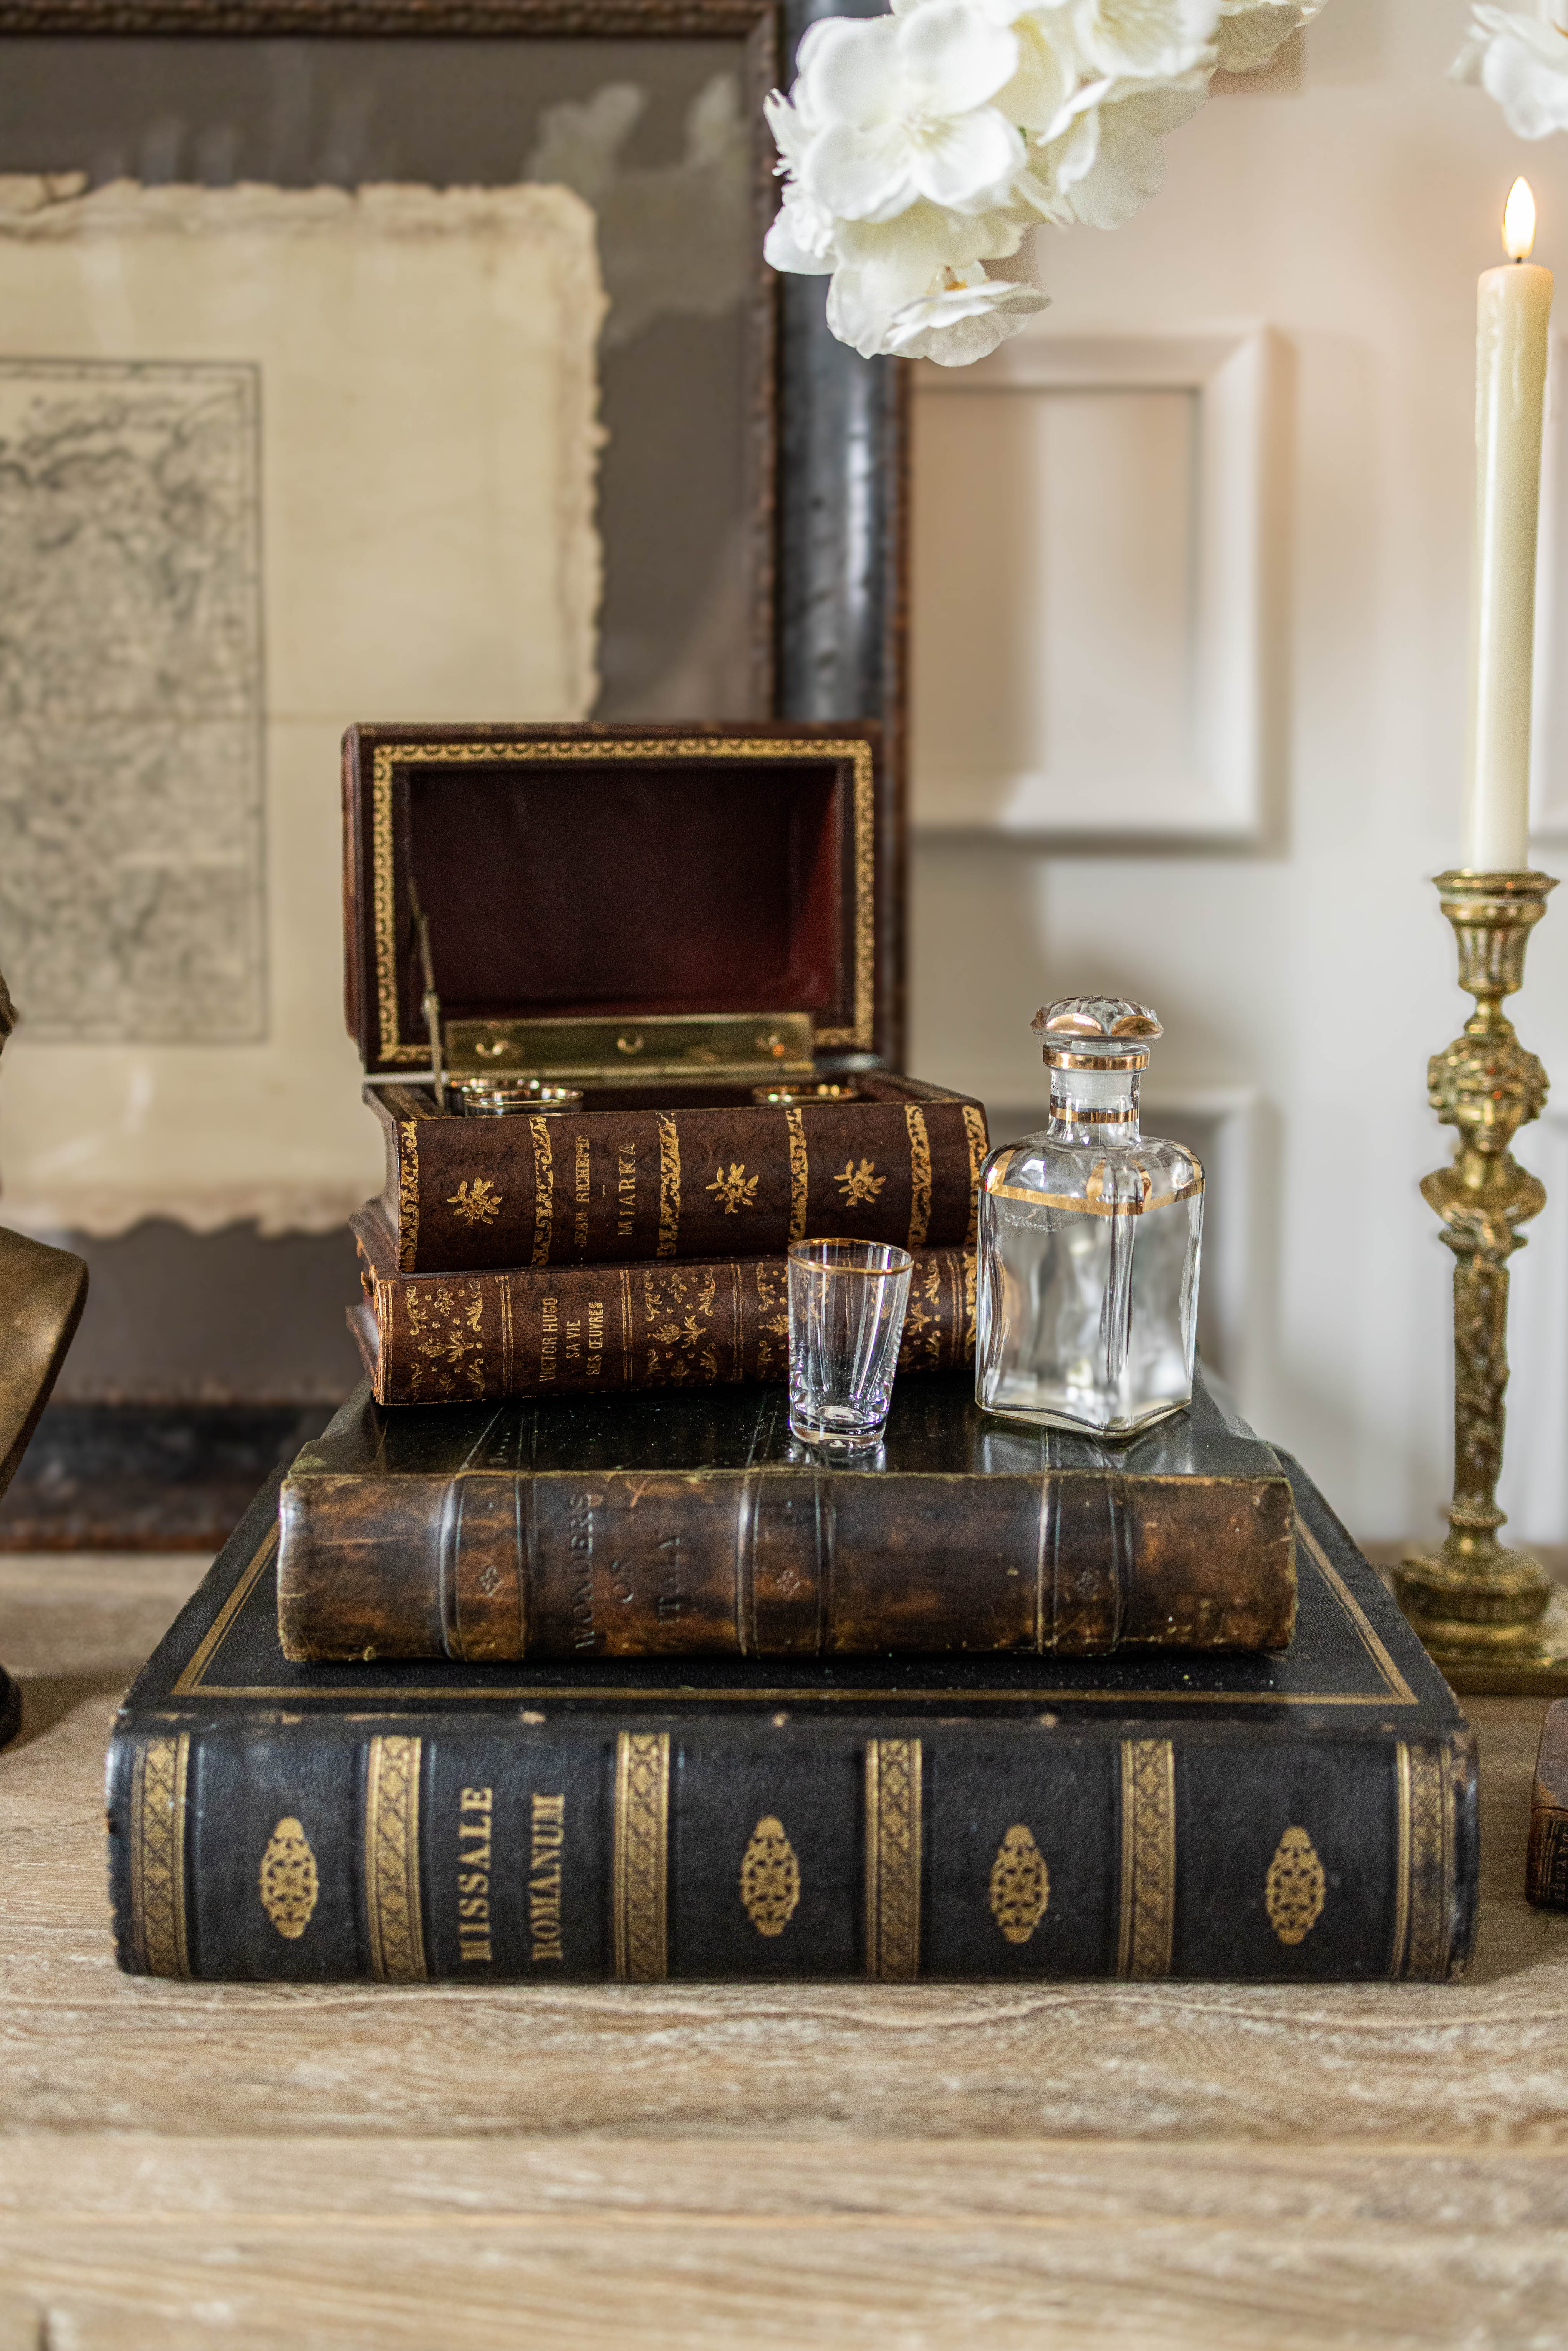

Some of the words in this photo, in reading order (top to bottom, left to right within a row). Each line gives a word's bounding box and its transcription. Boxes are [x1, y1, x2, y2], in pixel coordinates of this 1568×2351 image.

[617, 1142, 636, 1235] MIARKA
[574, 1212, 589, 1247] JEAN
[542, 1297, 558, 1332] HUGO
[566, 1319, 581, 1339] VIE
[539, 1337, 558, 1381] VICTOR
[565, 1343, 580, 1359] SA
[586, 1354, 602, 1375] SES
[569, 1493, 595, 1649] WONDERS
[458, 1786, 493, 1961] MISSALE
[528, 1792, 565, 1960] ROMANUM
